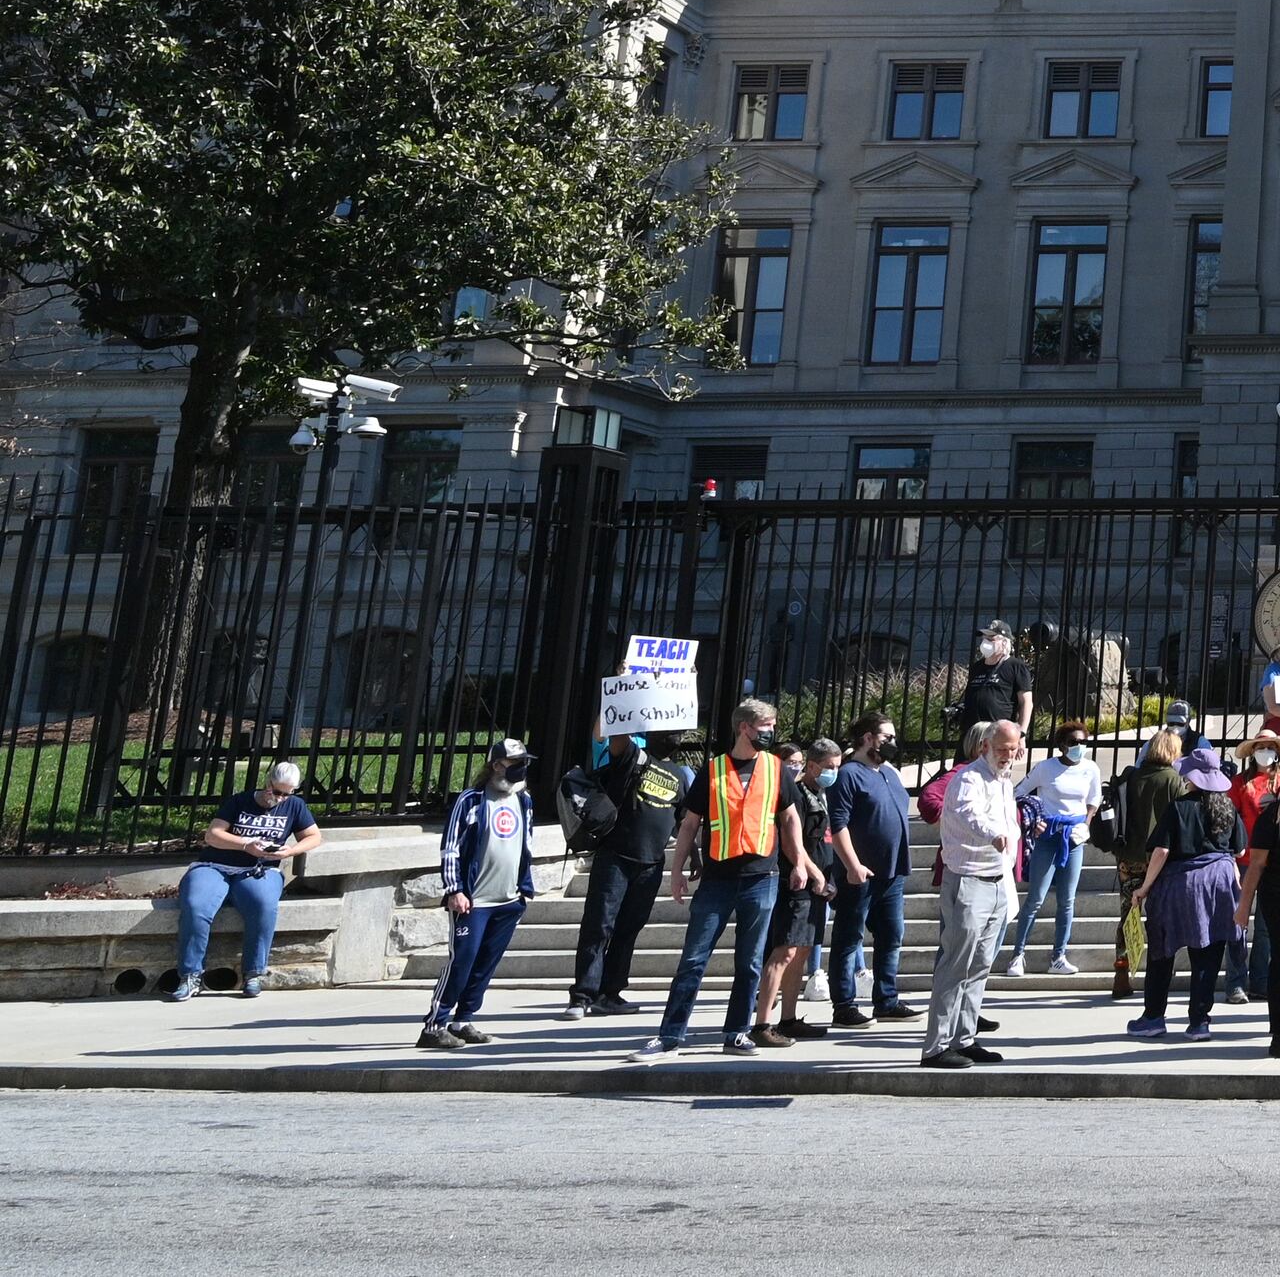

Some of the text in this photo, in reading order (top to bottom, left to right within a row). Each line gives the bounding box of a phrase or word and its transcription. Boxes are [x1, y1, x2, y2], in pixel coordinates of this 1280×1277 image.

[635, 639, 690, 660] TEACH
[603, 681, 650, 696] Whose
[605, 705, 634, 725] Our
[238, 813, 288, 828] WHEN
[232, 826, 284, 838] INJUSTICE
[456, 927, 469, 936] 32
